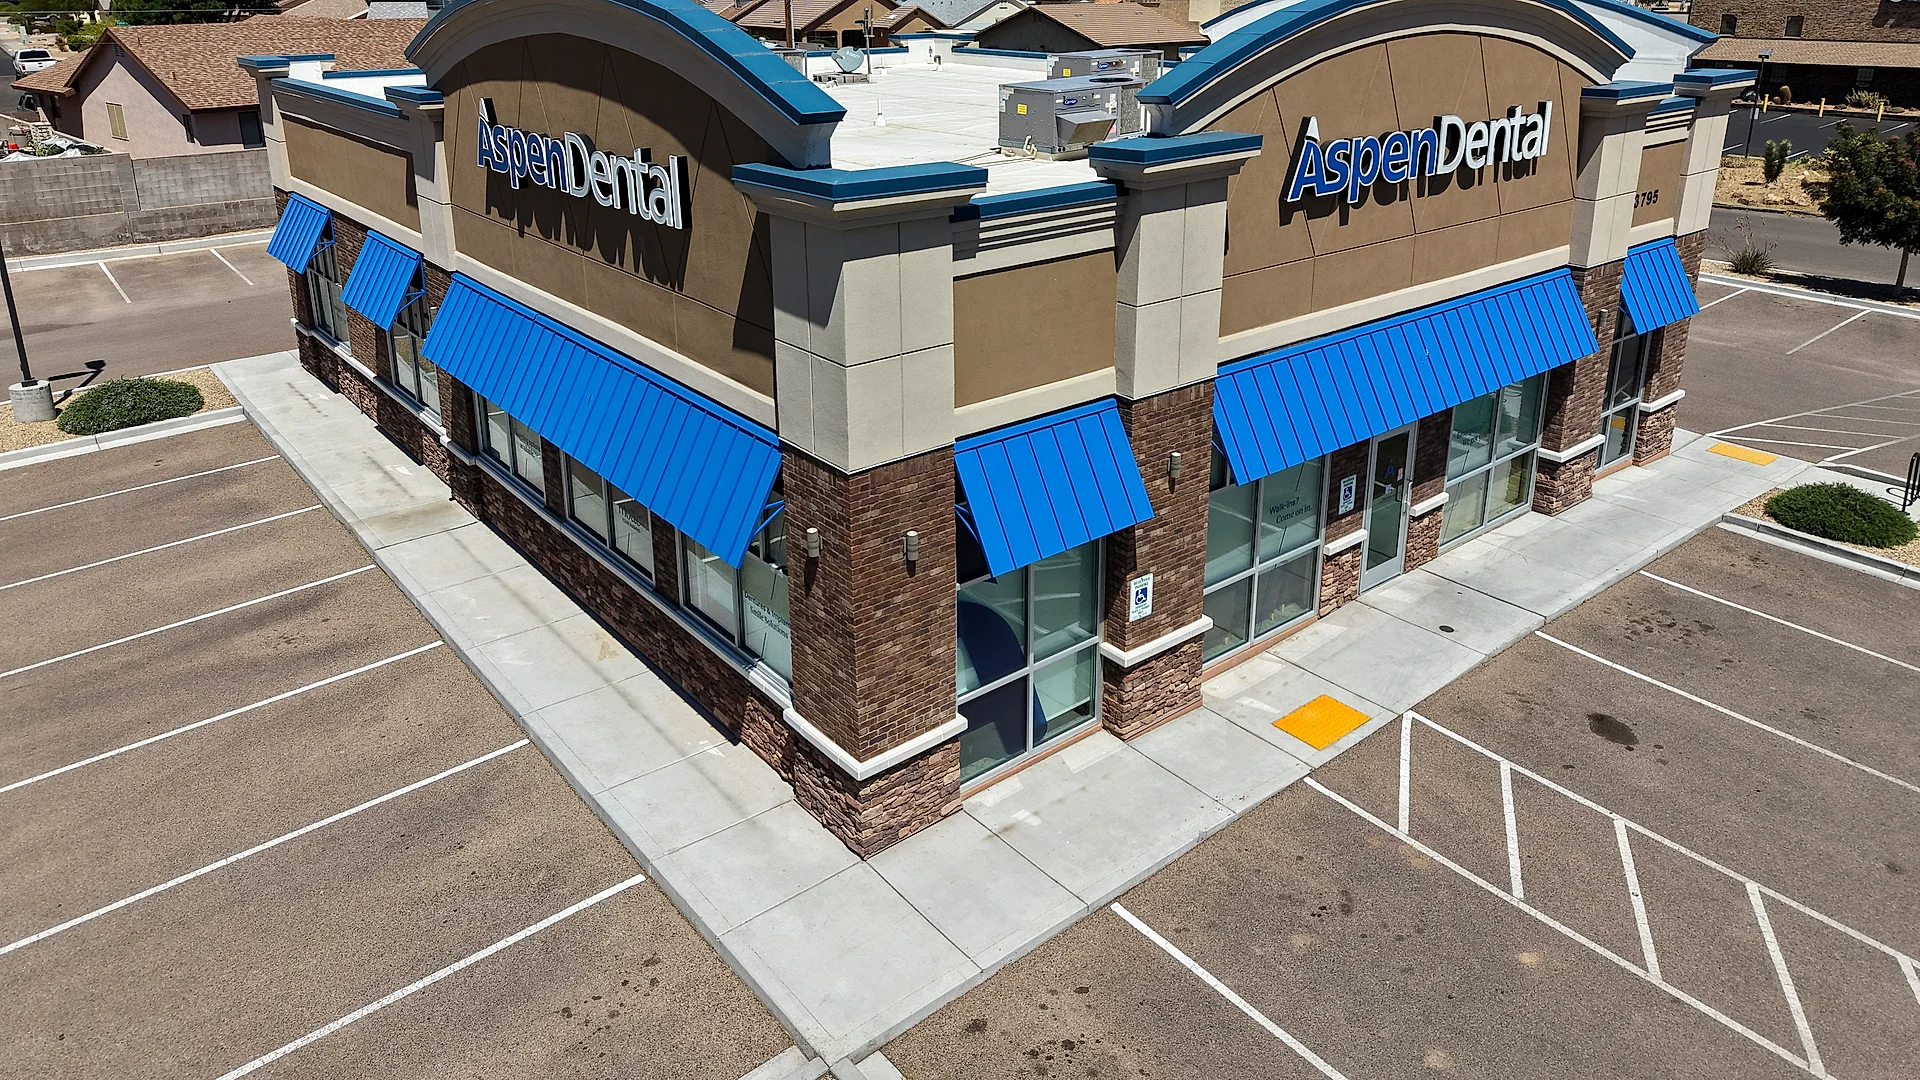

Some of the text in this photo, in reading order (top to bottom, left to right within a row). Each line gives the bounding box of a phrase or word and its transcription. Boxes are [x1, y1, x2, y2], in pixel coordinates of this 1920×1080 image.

[1633, 188, 1660, 209] 3795
[1269, 496, 1300, 515] Walk-ins?
[1276, 503, 1313, 524] Come on in.
[744, 590, 766, 611] Dentures
[750, 605, 789, 639] Smile Solutions
